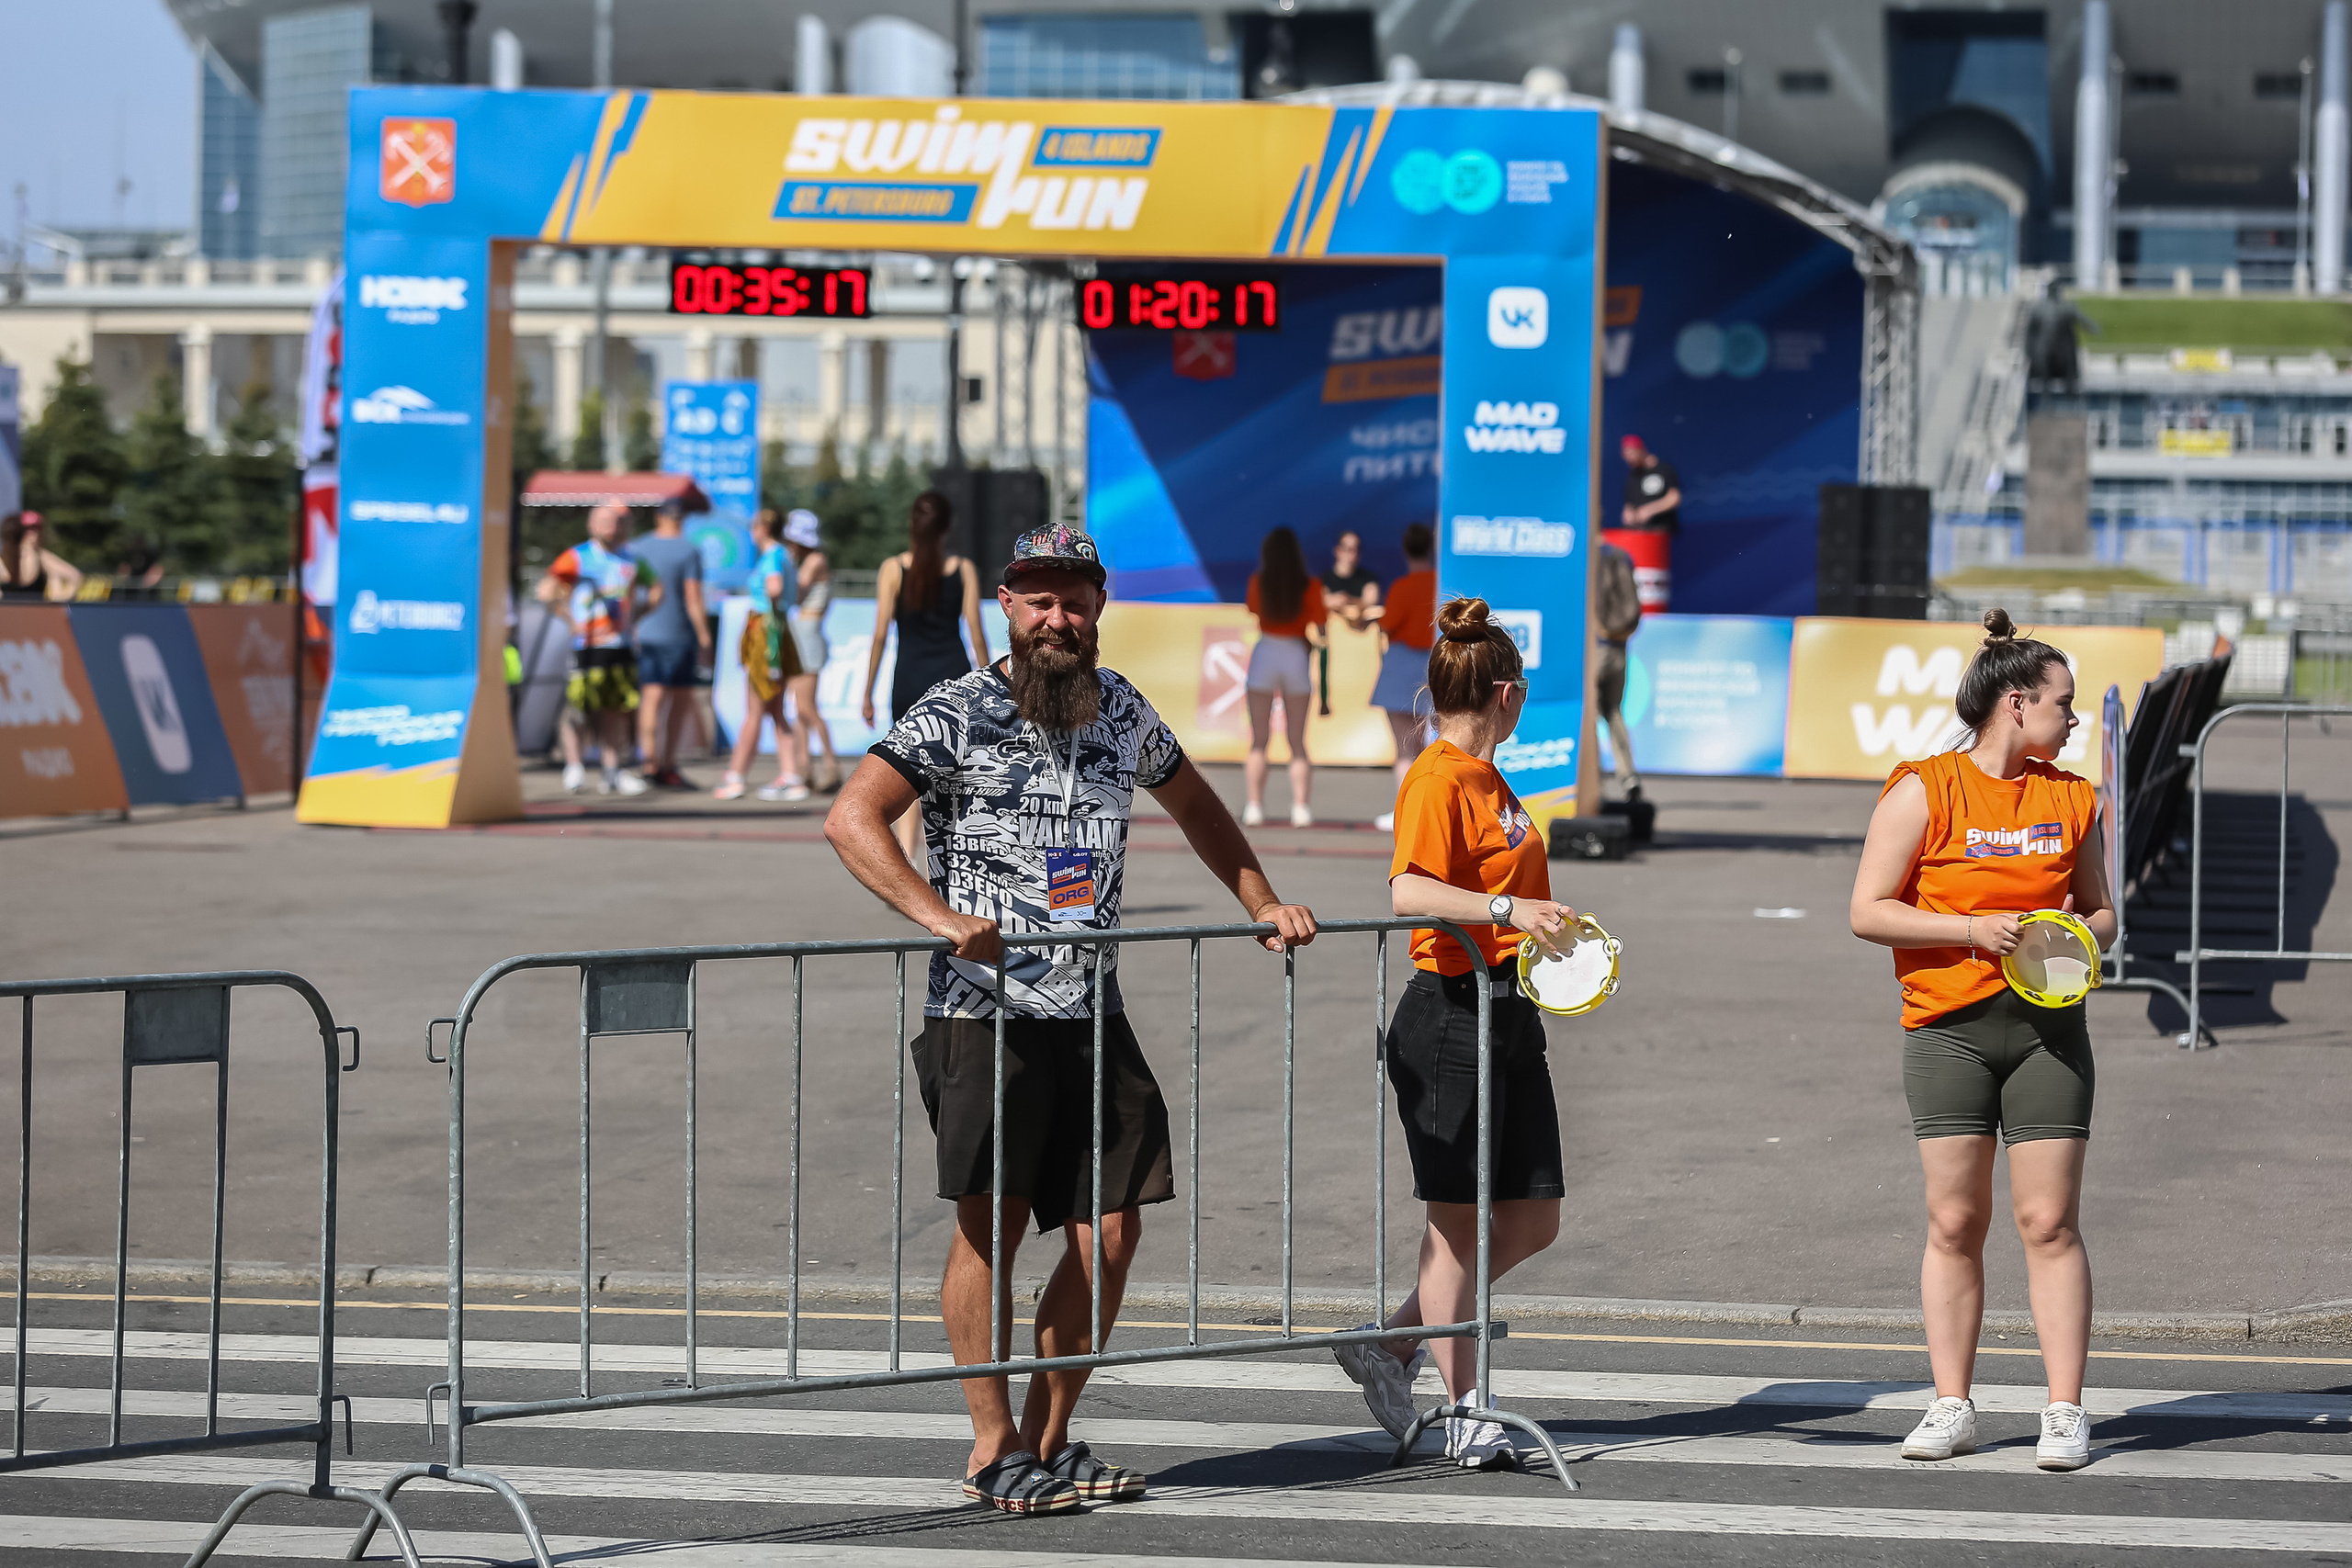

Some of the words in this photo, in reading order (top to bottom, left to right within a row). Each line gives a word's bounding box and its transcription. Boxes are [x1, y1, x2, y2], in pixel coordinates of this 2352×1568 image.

[827, 186, 955, 217] PETERSBURG
[1475, 400, 1560, 428] MAD
[1464, 425, 1567, 455] WAVE
[1019, 795, 1041, 814] 20
[1043, 797, 1066, 816] km
[1053, 886, 1090, 905] ORG
